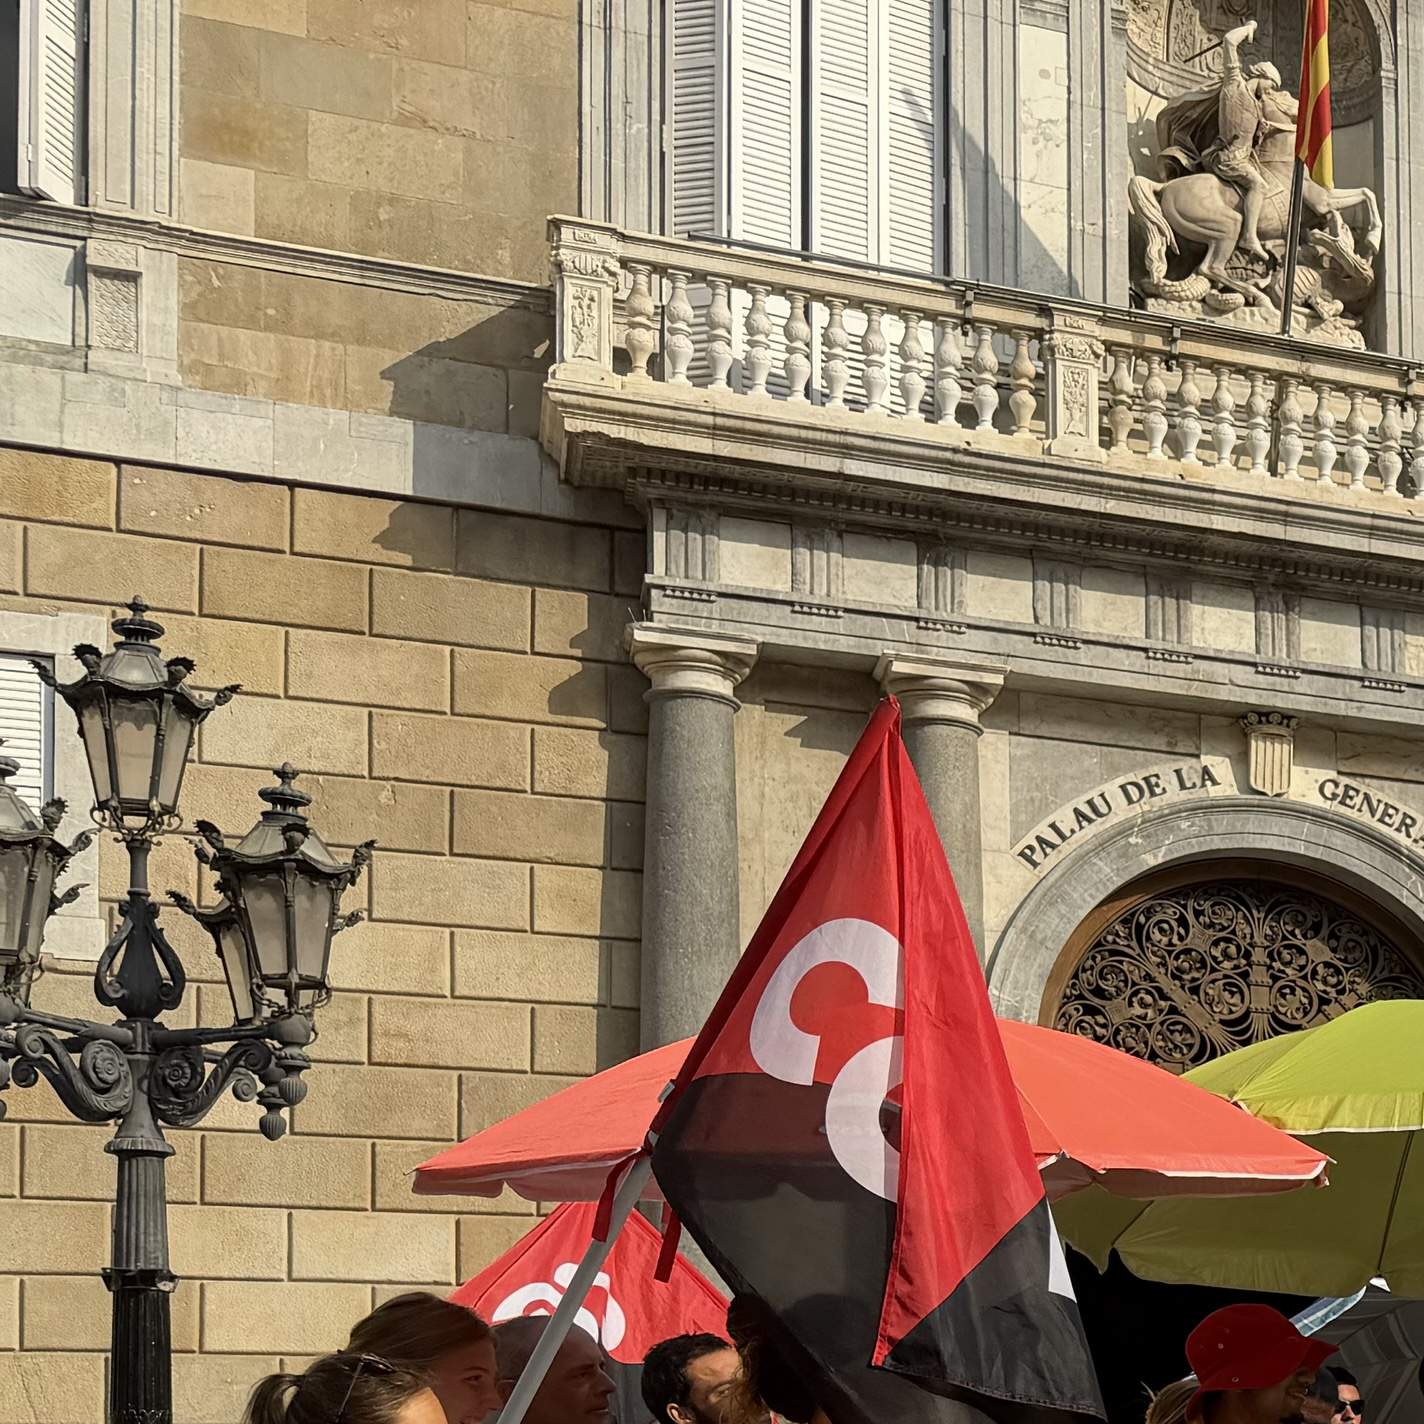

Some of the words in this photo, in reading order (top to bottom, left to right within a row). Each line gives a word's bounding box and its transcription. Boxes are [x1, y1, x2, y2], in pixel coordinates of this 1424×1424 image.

[1017, 791, 1113, 870] PALAU
[1118, 772, 1167, 806] DE
[1173, 764, 1222, 792] LA
